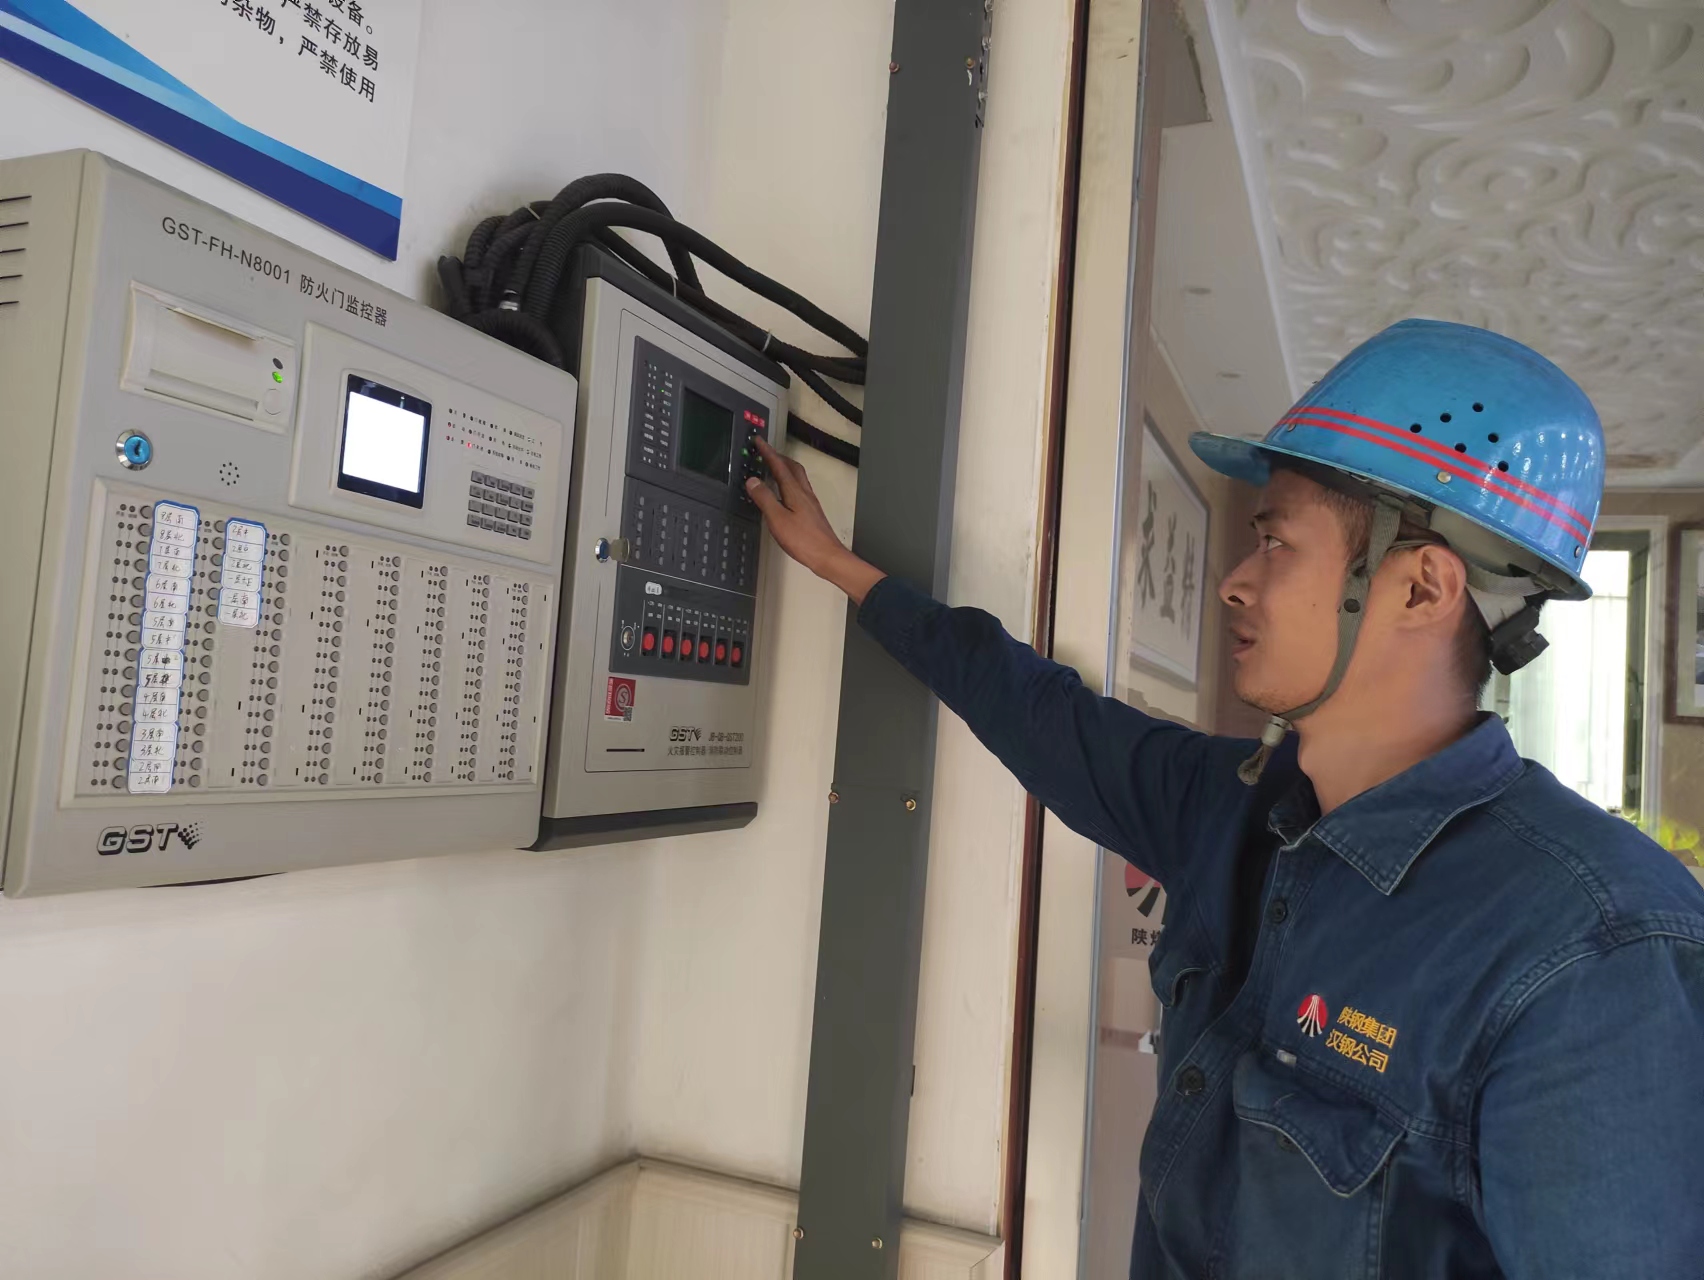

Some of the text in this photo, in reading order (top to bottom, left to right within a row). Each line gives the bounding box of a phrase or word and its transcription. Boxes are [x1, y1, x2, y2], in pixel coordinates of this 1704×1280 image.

[220, 0, 376, 103] 杂物，严禁使用
[161, 216, 387, 327] GST-FH-N8001 防火门监控器
[97, 823, 179, 856] GST
[1337, 1006, 1397, 1049] 陕钢集团
[1325, 1029, 1389, 1073] 汉钢公司
